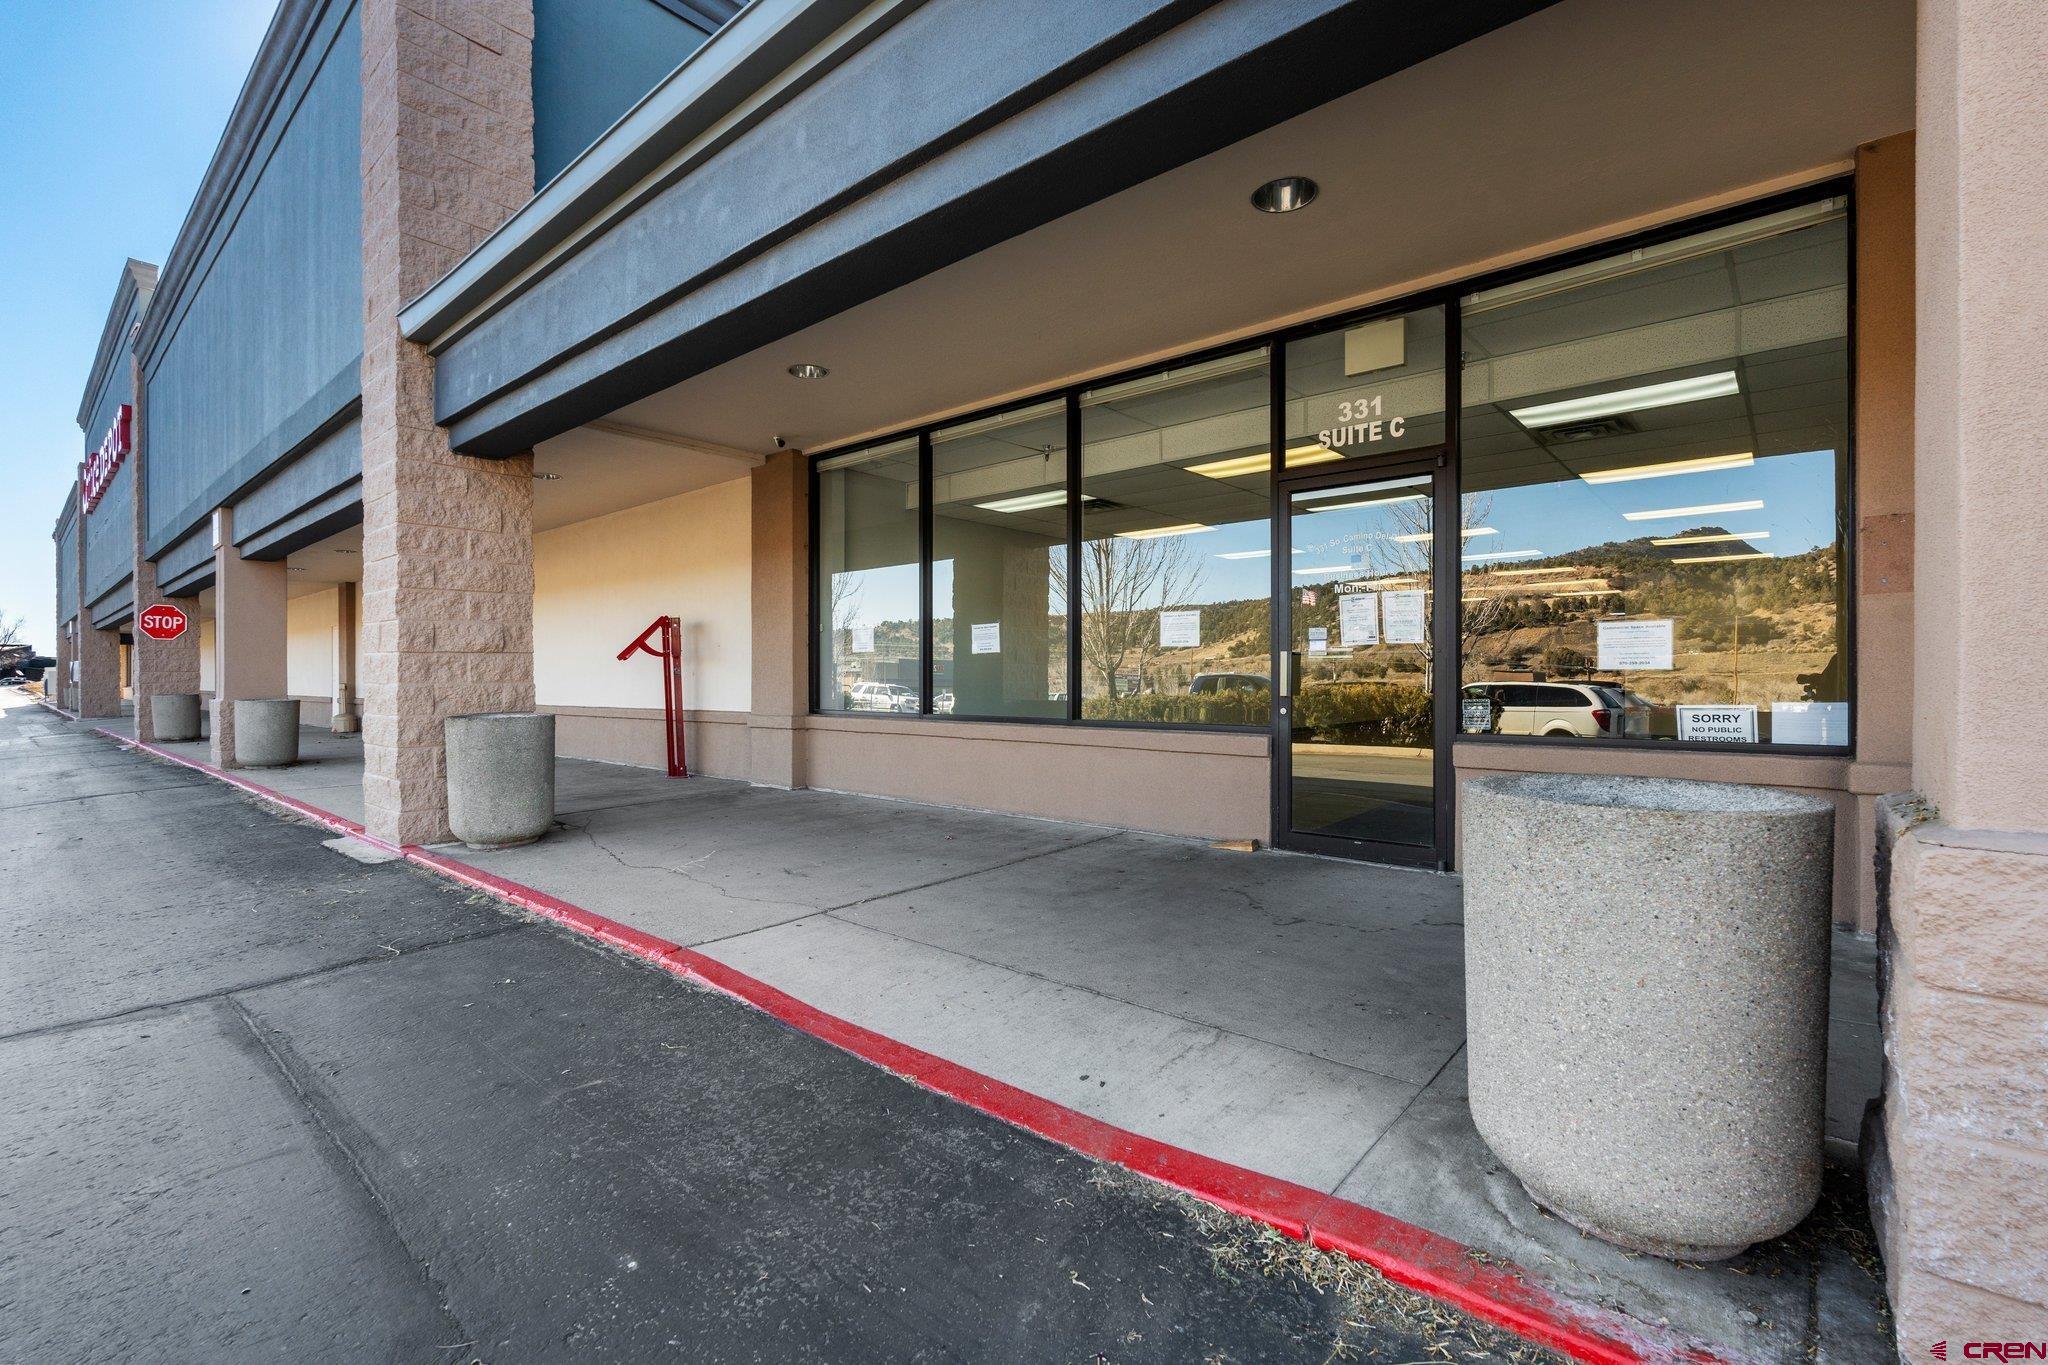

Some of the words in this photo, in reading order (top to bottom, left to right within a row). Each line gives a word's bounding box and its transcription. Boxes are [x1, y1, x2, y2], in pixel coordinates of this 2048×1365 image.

[1338, 395, 1382, 422] 331
[1318, 420, 1383, 449] SUITE
[1389, 416, 1405, 438] C
[143, 615, 183, 629] STOP
[1692, 714, 1741, 723] SORRY
